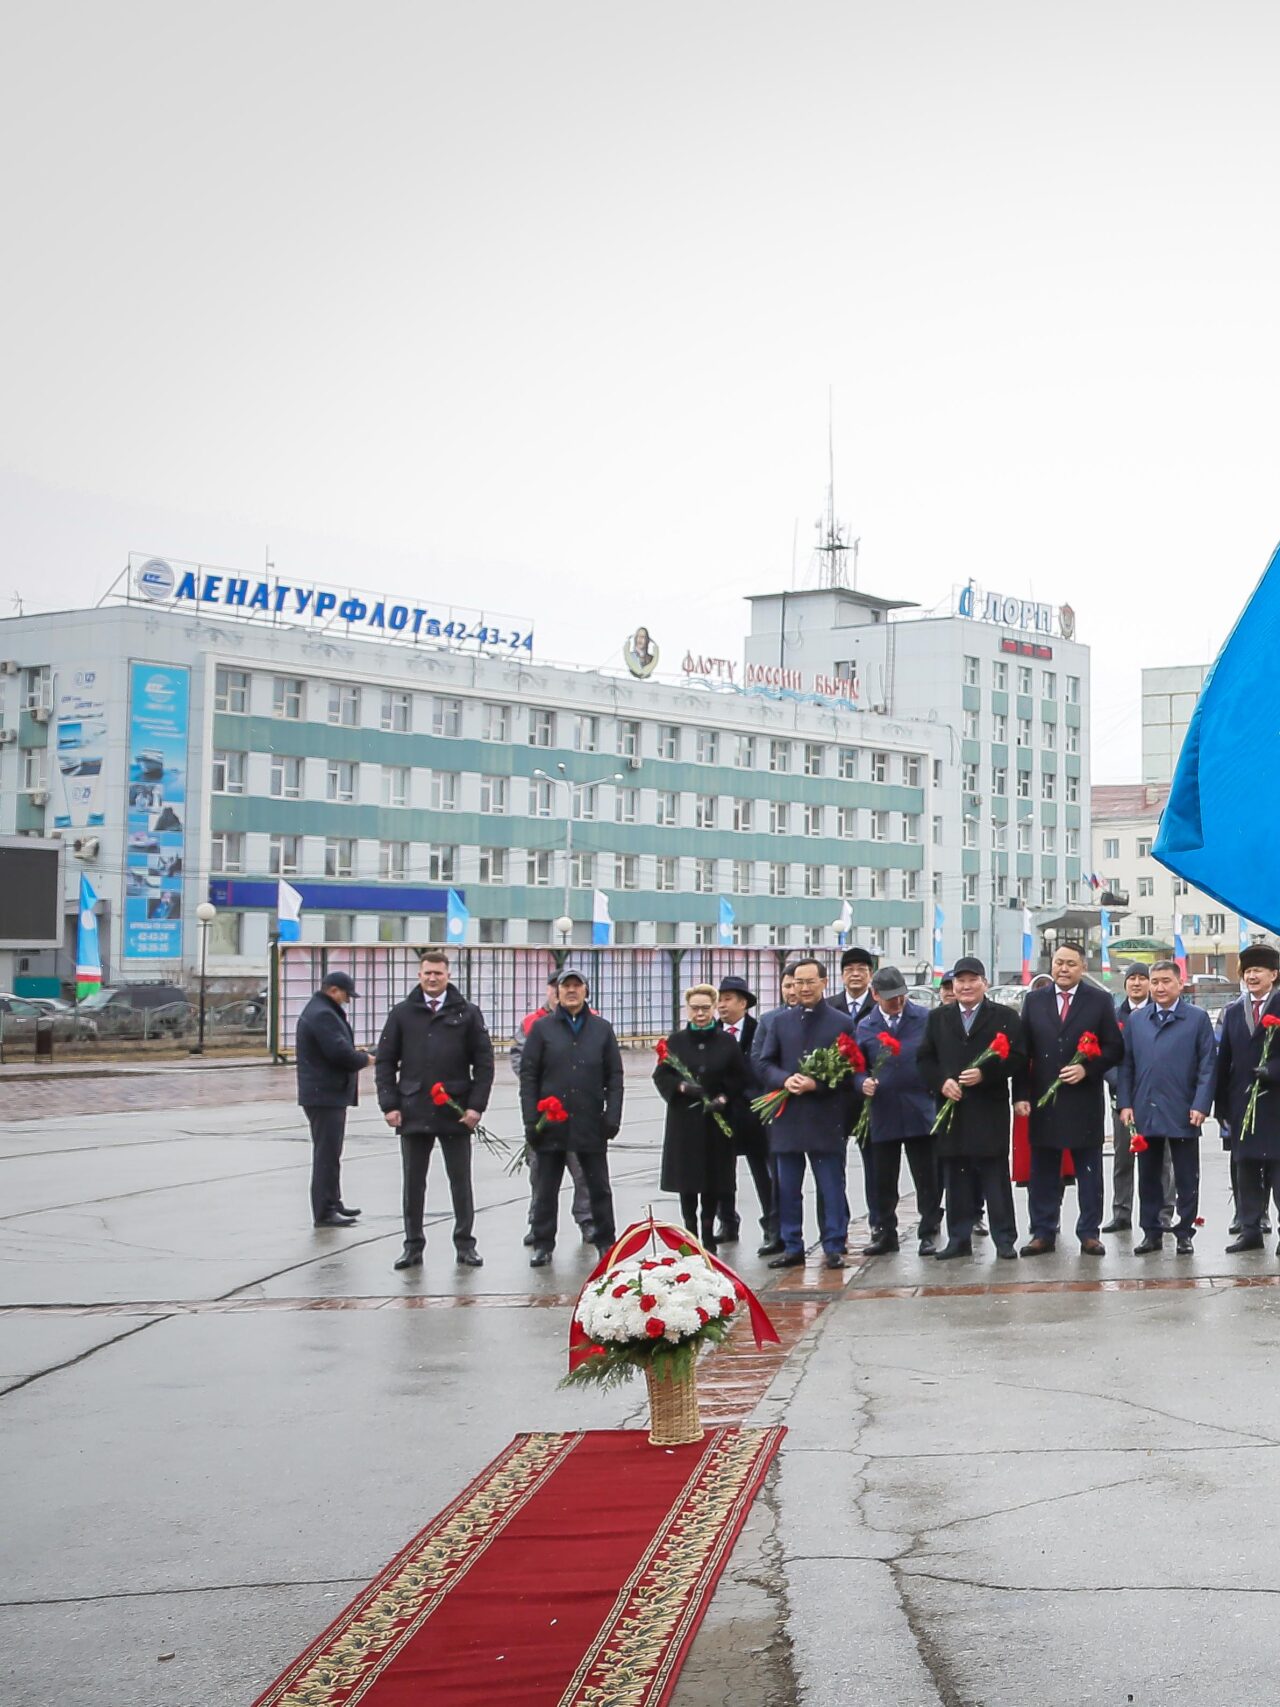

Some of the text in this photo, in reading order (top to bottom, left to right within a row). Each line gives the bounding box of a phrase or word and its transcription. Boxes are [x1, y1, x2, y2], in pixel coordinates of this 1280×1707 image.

[175, 571, 534, 650] ЛЕНАТУРФЛОТ 42-43-24
[983, 592, 1053, 633] ЛОРП
[682, 650, 737, 683] ФЛОТУ
[747, 662, 802, 690] РОССИИ
